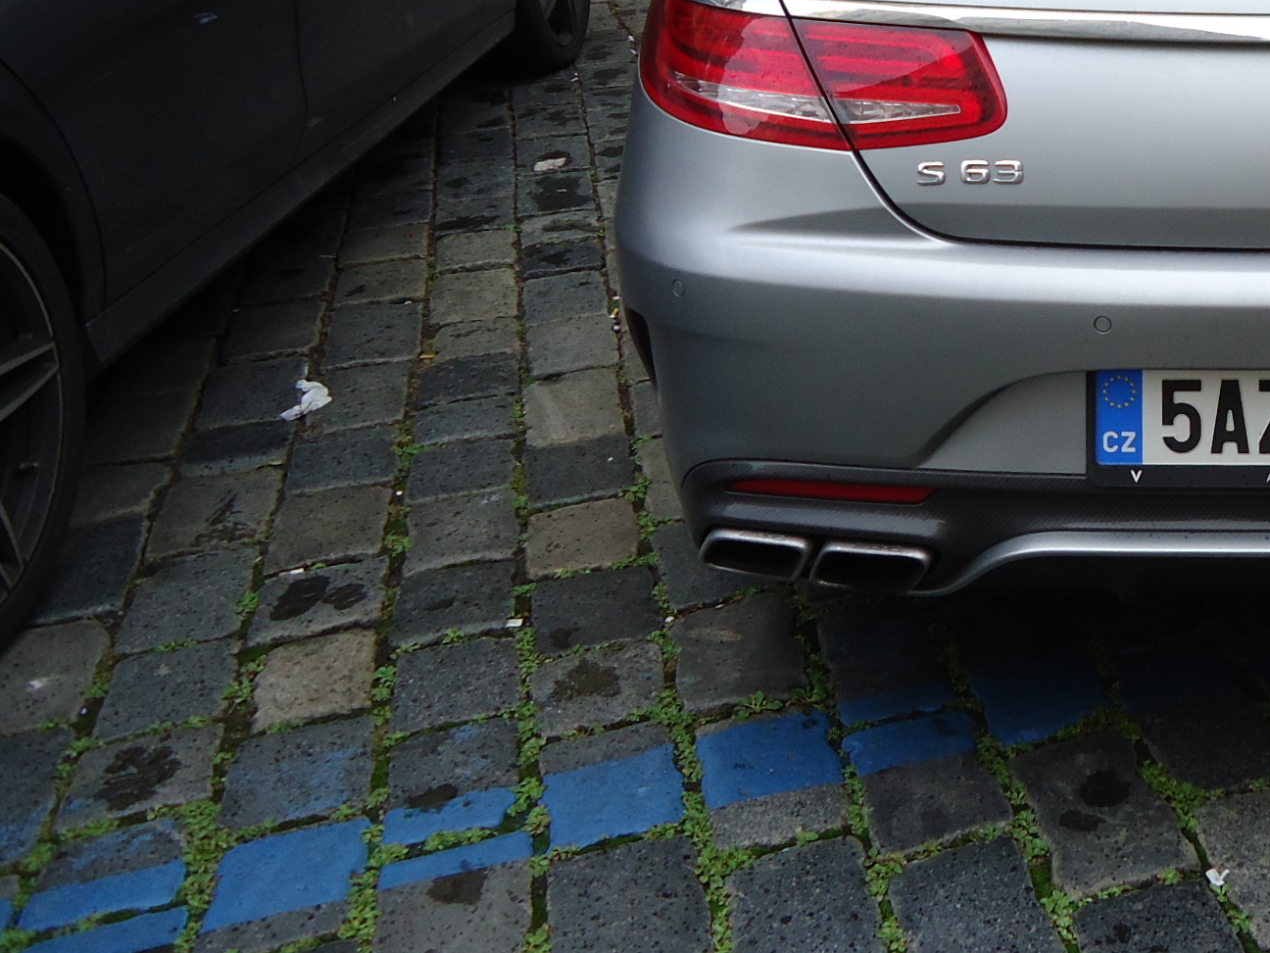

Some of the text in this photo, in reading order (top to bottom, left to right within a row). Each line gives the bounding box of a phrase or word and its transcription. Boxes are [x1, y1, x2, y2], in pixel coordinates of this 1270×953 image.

[917, 159, 1024, 186] S 63
[1103, 431, 1136, 453] CZ
